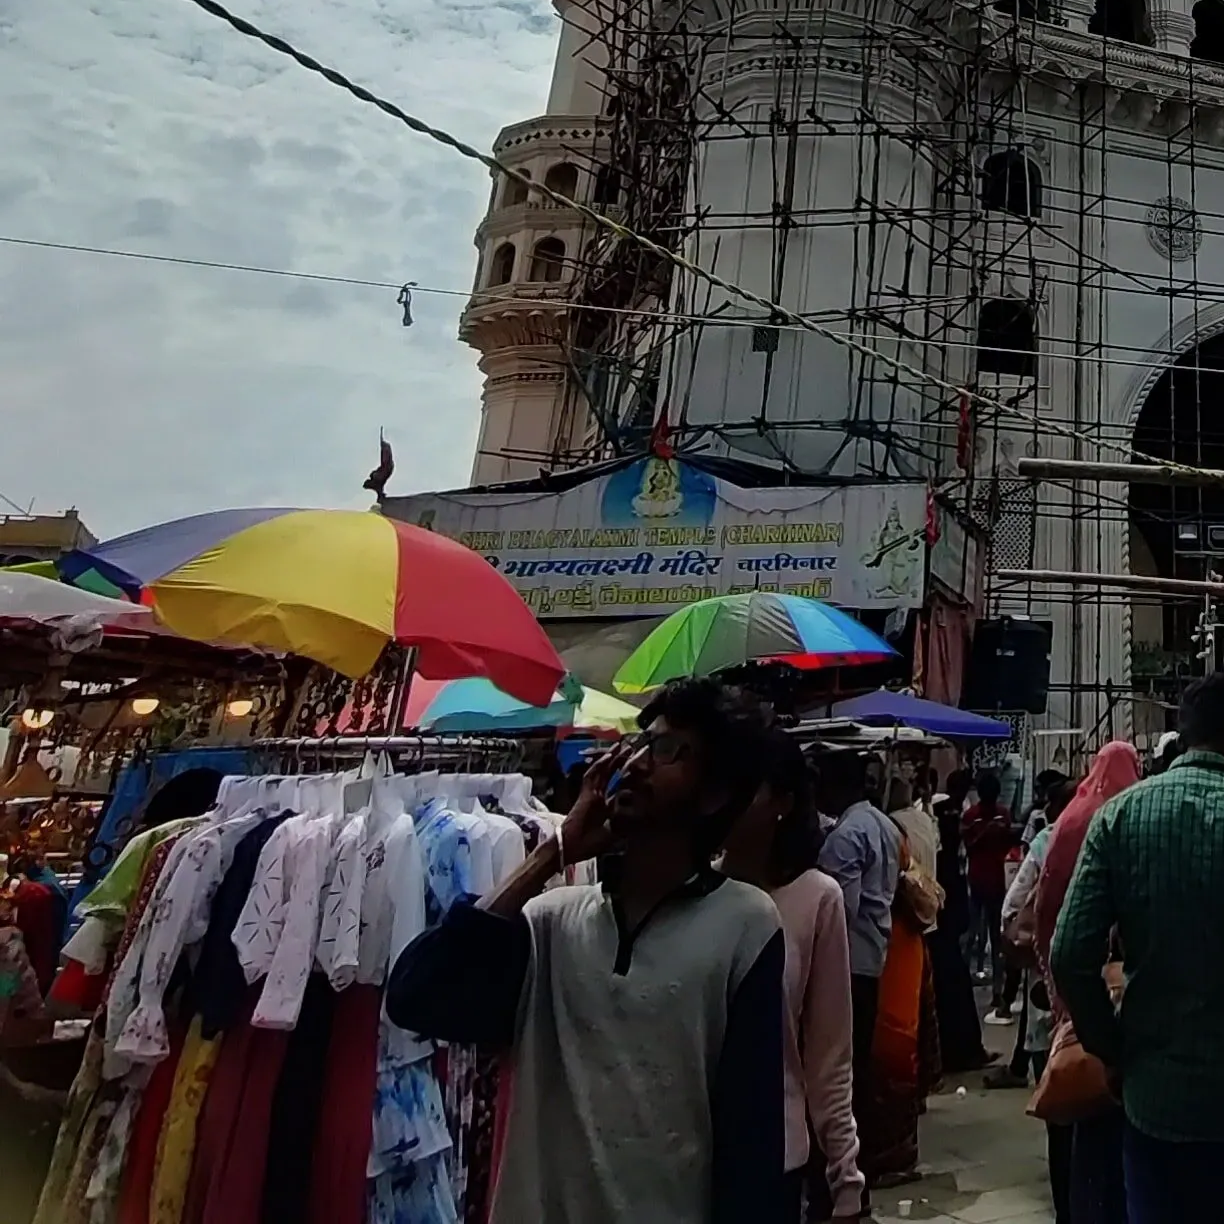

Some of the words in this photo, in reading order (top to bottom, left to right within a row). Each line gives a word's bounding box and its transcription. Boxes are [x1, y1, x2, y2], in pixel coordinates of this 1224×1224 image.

[507, 527, 641, 550] BHAGYALAXMI
[644, 525, 717, 547] TEMPLE
[720, 522, 844, 550] (CHARMINAR)
[504, 551, 655, 577] भाग्यलक्ष्मी
[658, 550, 724, 576] मंदिर
[736, 552, 837, 572] चारमिनार
